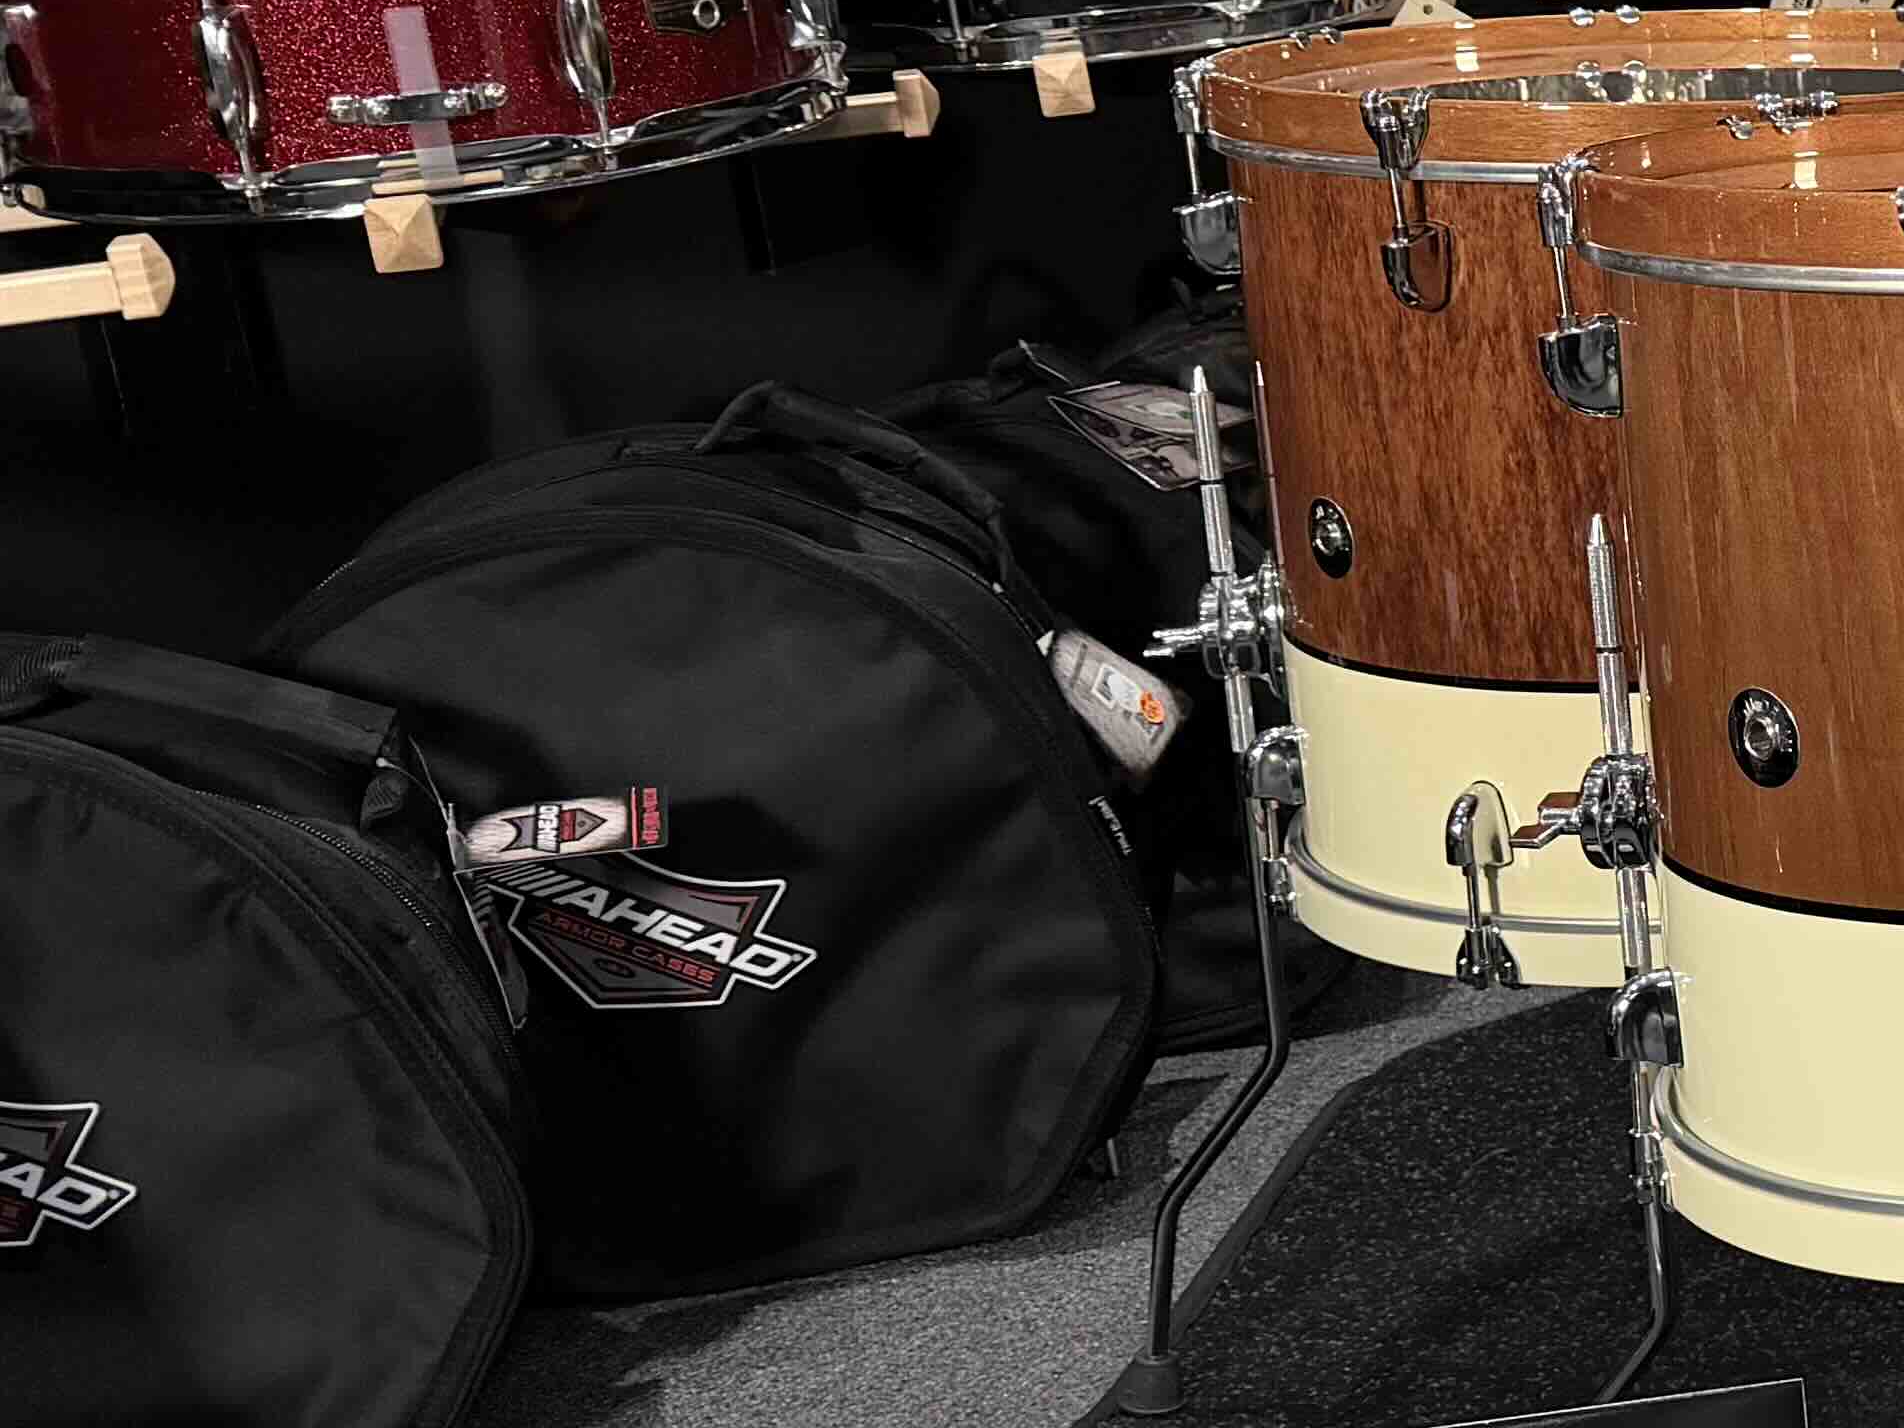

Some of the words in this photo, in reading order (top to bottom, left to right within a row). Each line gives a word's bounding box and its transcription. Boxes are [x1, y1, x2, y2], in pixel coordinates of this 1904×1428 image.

[538, 804, 560, 853] AHEAD
[552, 884, 798, 977] AHEAD
[630, 942, 717, 984] CASES
